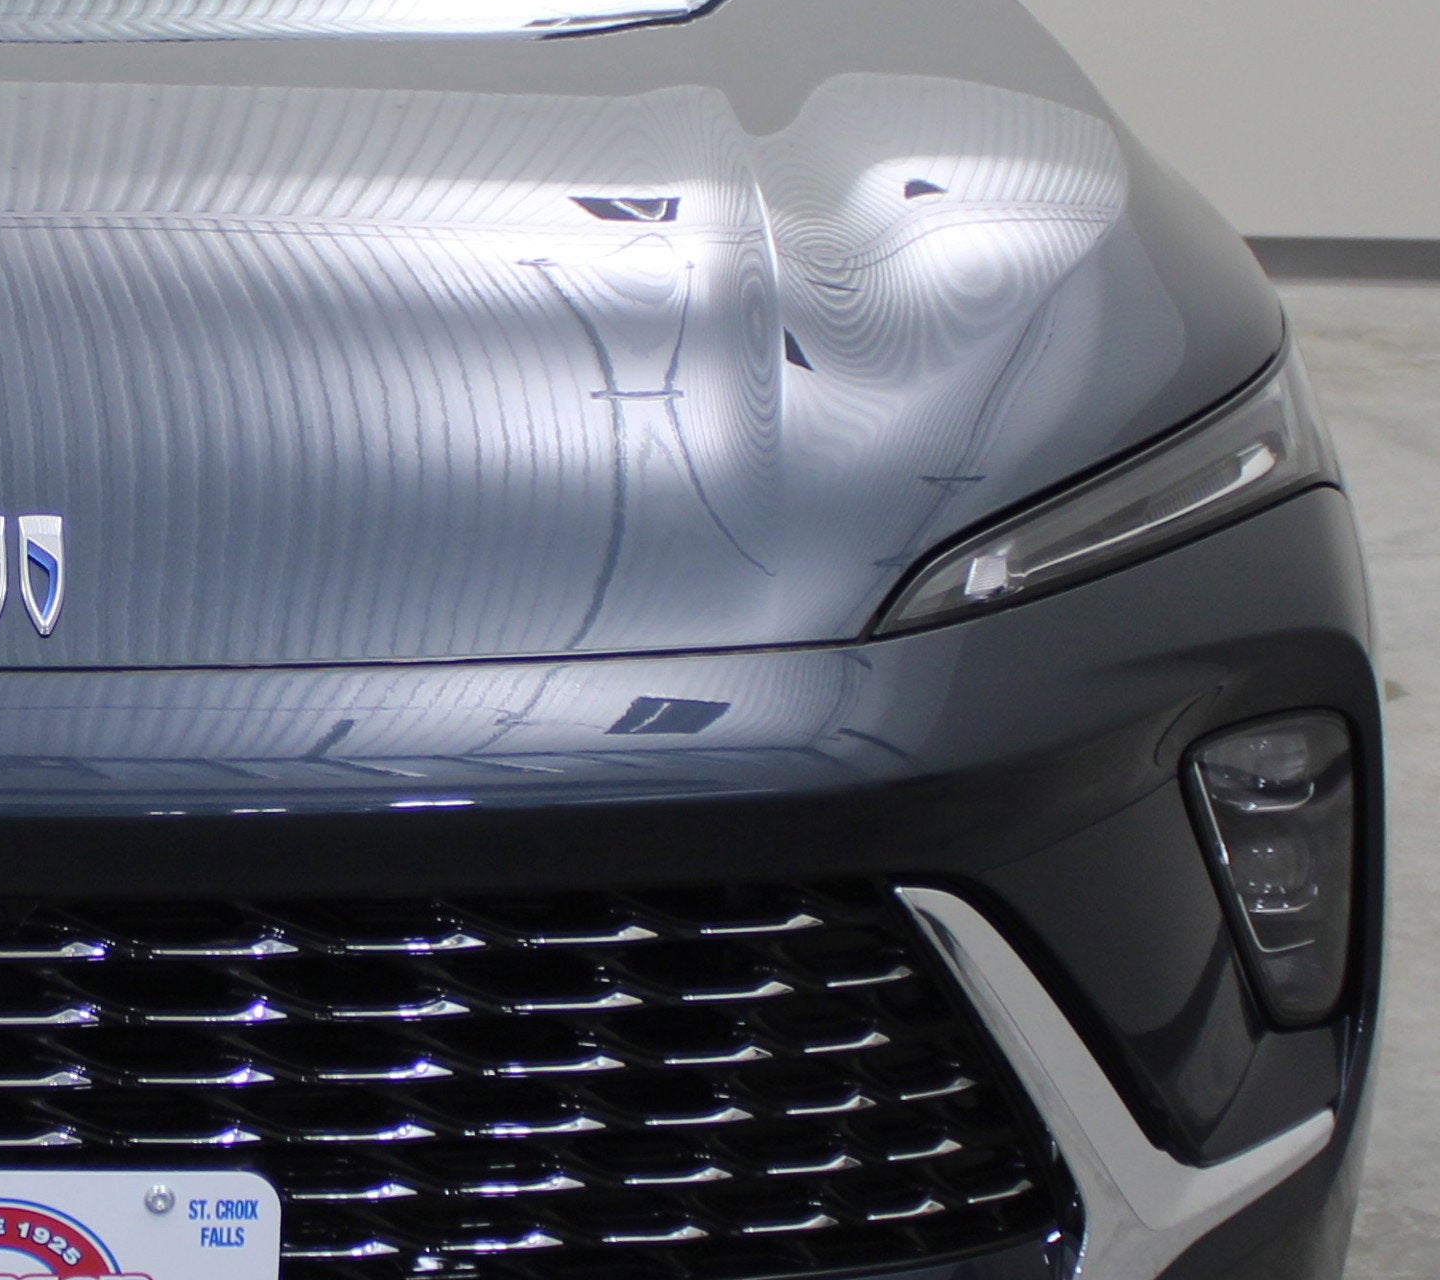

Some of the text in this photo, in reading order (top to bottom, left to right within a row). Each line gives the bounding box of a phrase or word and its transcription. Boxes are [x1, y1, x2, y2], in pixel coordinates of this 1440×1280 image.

[188, 1199, 259, 1221] ST. CROIX
[18, 1221, 82, 1266] 1925
[200, 1227, 245, 1248] FALLS
